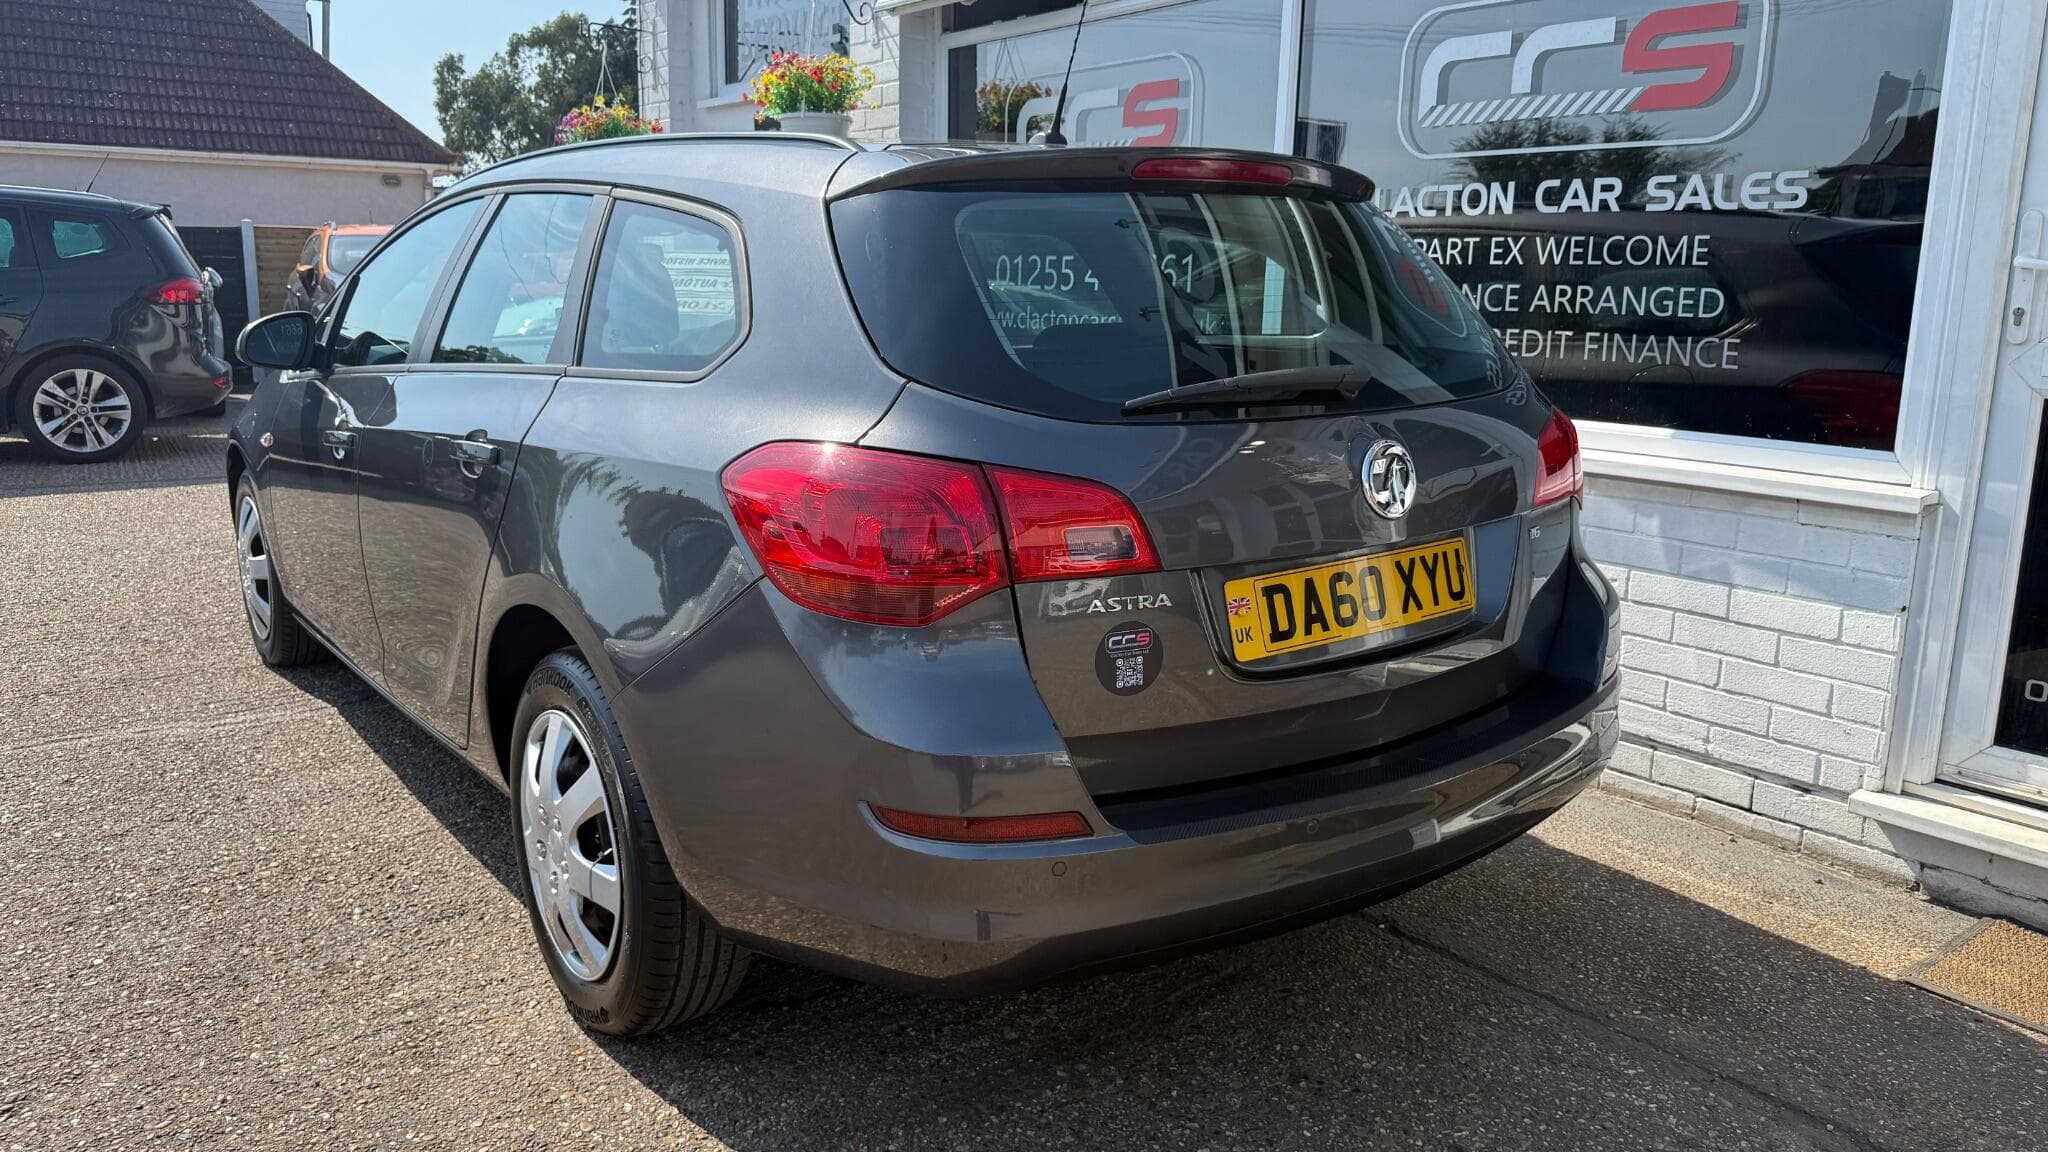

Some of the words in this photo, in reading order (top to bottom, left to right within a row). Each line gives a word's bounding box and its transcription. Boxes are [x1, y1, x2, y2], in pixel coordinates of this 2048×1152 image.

[1536, 177, 1623, 213] CAR
[1646, 170, 1811, 212] SALES
[1489, 236, 1527, 265] EX
[1536, 235, 1711, 267] WELCOME
[996, 254, 1075, 292] 01255
[1529, 284, 1725, 319] ARRANGED
[1584, 332, 1742, 370] FINANCE
[1086, 593, 1173, 614] ASTRA
[1261, 565, 1388, 644] DA60
[1394, 548, 1466, 614] XYU
[1234, 625, 1254, 644] UK
